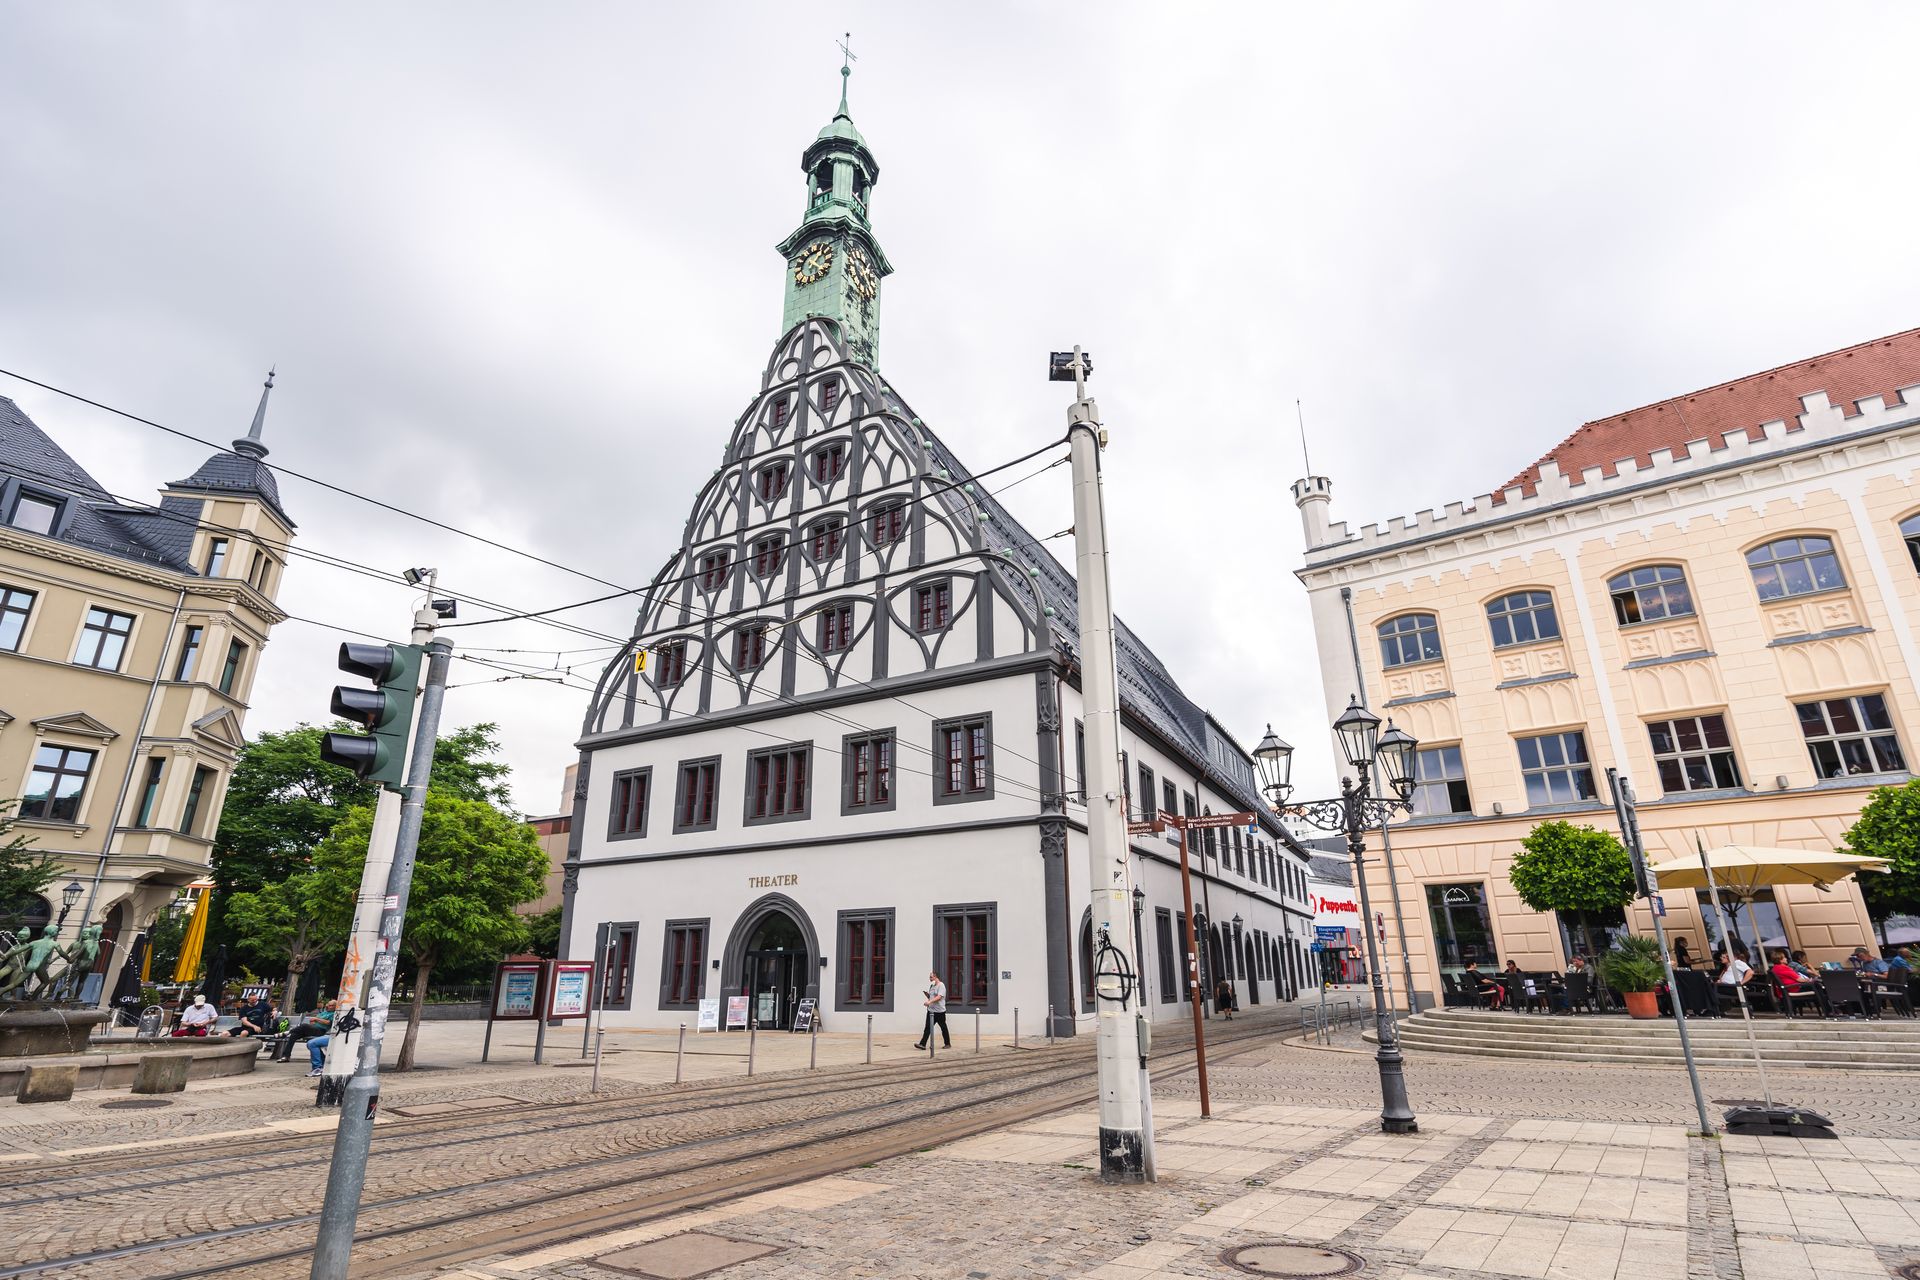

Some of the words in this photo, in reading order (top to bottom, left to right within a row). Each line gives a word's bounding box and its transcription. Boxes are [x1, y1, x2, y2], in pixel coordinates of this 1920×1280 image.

[638, 653, 645, 671] 2
[748, 874, 798, 888] THEATER
[1320, 896, 1358, 914] Puppenthe
